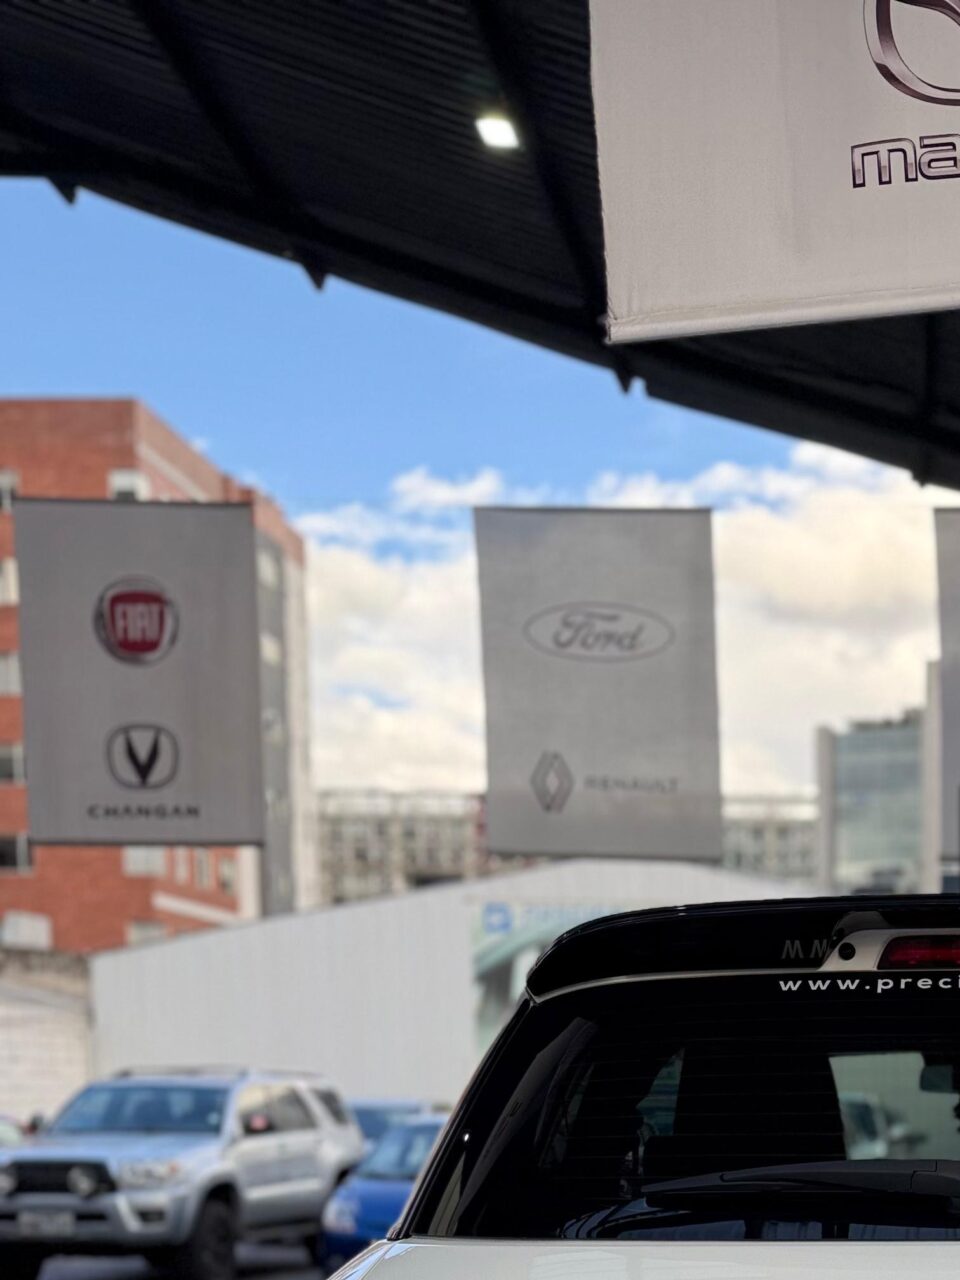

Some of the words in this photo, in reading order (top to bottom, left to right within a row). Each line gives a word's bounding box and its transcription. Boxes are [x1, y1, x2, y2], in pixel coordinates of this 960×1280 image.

[114, 604, 164, 643] FIAT
[553, 610, 644, 649] Ford
[87, 804, 200, 819] CHANGAN
